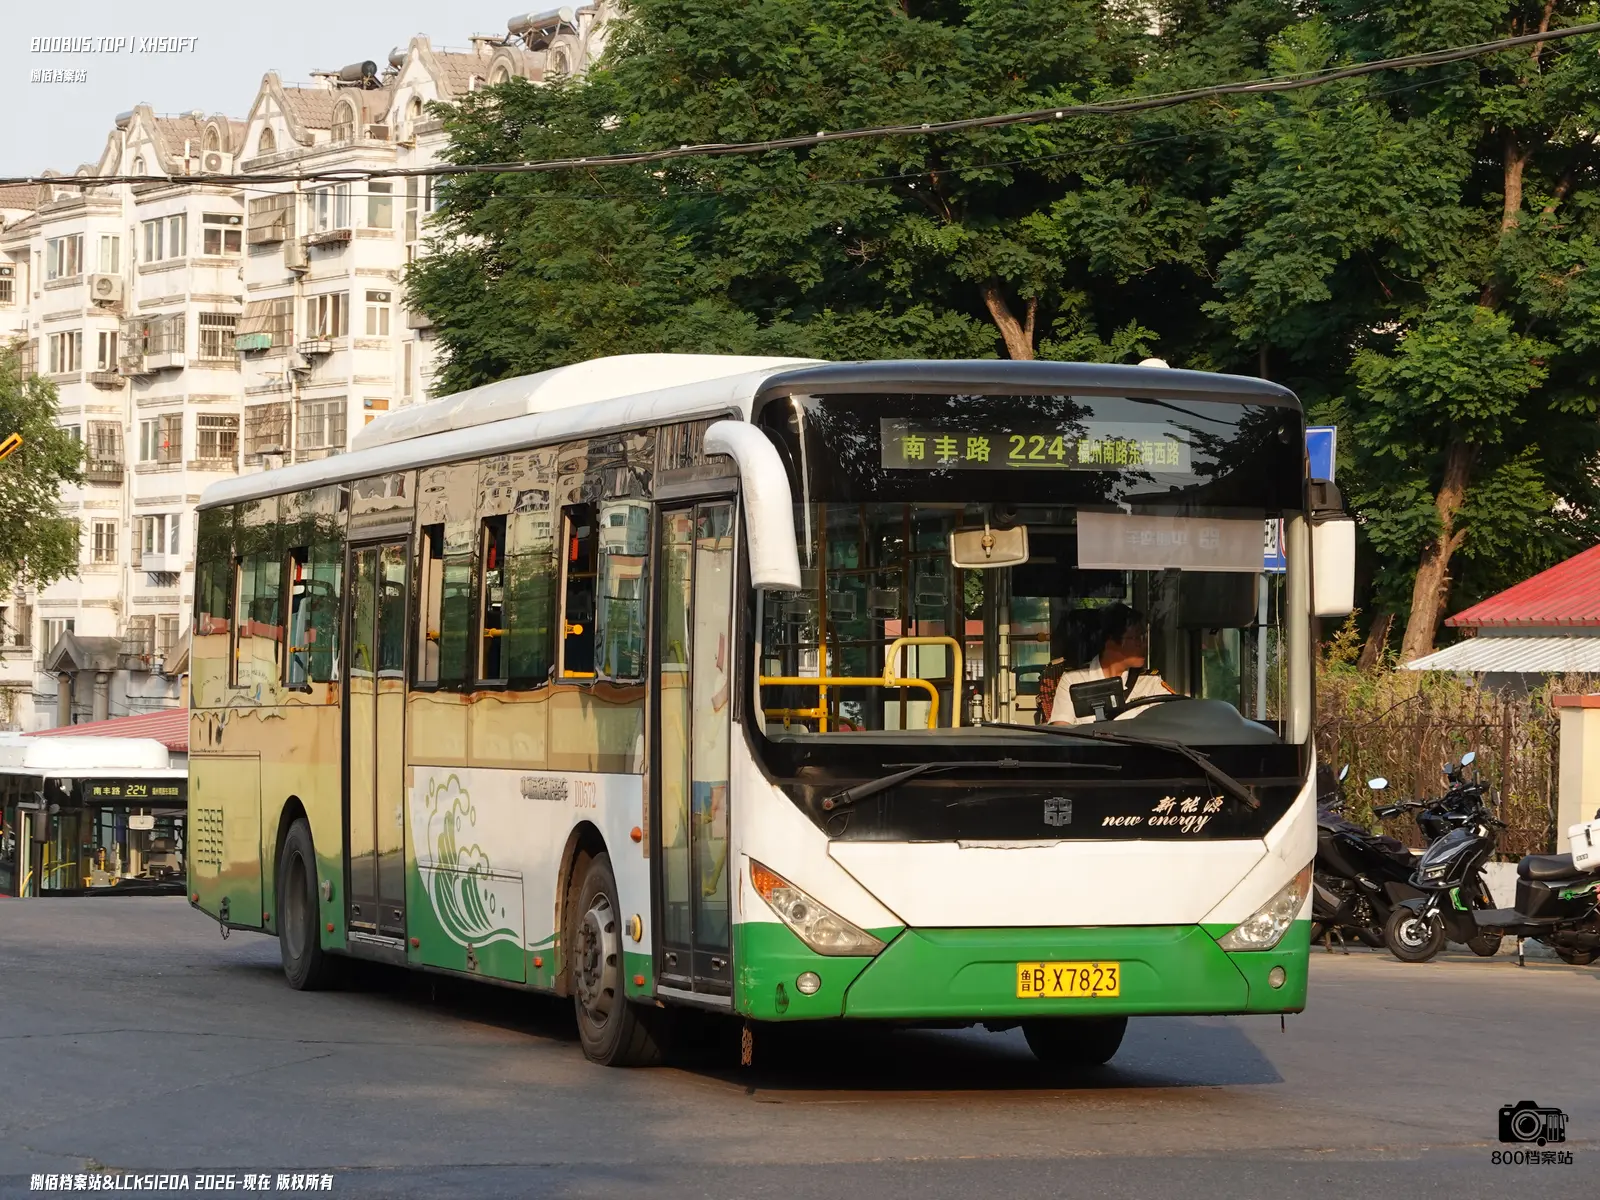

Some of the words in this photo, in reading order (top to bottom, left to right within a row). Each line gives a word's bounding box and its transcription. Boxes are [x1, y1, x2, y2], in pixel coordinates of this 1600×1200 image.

[901, 434, 991, 462] 南丰路
[1008, 434, 1066, 460] 224
[1077, 438, 1180, 466] 福州南路东海西路
[93, 787, 121, 796] 南丰路
[126, 784, 147, 796] 224
[1152, 795, 1225, 815] 新能源
[1101, 814, 1144, 827] new
[1148, 814, 1213, 834] energy
